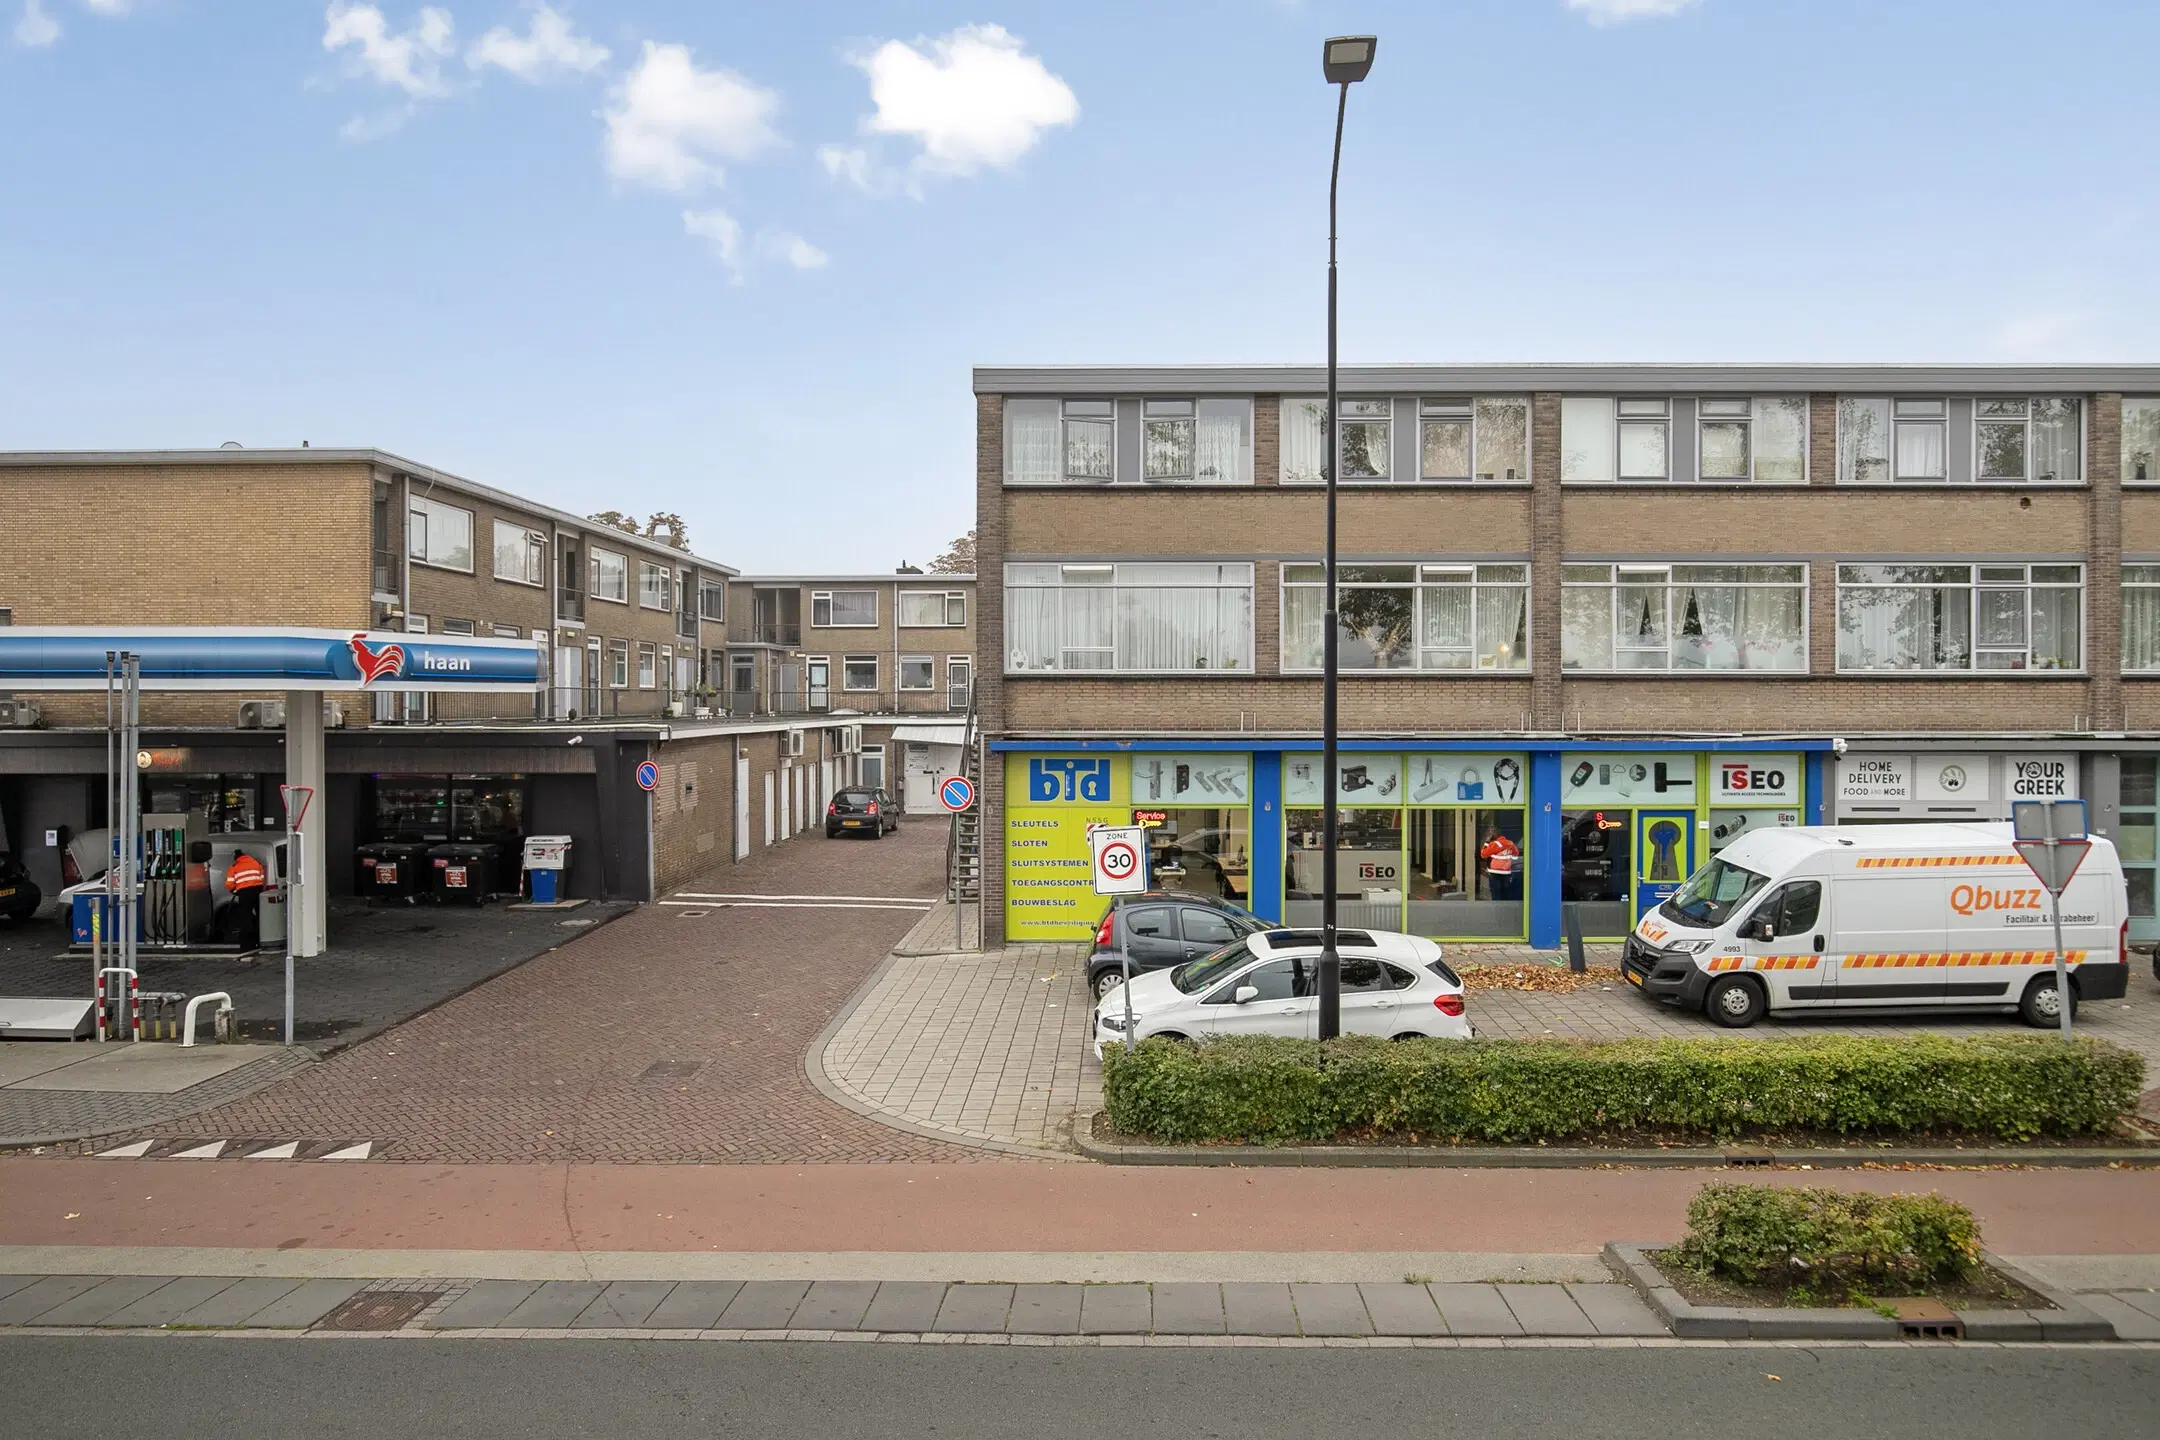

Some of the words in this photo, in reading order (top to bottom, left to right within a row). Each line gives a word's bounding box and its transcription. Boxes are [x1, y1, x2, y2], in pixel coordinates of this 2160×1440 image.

[424, 651, 470, 670] haan
[1859, 761, 1892, 772] HOME
[2015, 762, 2064, 779] YOUR
[1722, 764, 1785, 790] ISEO
[1848, 774, 1901, 784] DELIVERY
[1843, 788, 1869, 796] FOOD
[1884, 788, 1906, 796] MORE
[2013, 779, 2065, 796] GREEK
[1136, 811, 1166, 821] Service
[1778, 813, 1795, 822] ISEO
[1011, 820, 1059, 828] SLEUTELS
[1106, 832, 1128, 840] ZONE
[1107, 853, 1131, 869] 30
[1359, 863, 1396, 878] ISEO
[1011, 879, 1094, 887] TOEGANGSCONTR
[1011, 899, 1076, 907] BOUWBESLAG
[1950, 884, 2041, 916] Qbuzz
[2006, 914, 2040, 924] Facilitair
[2042, 914, 2048, 923] &
[1723, 945, 1741, 953] 4993
